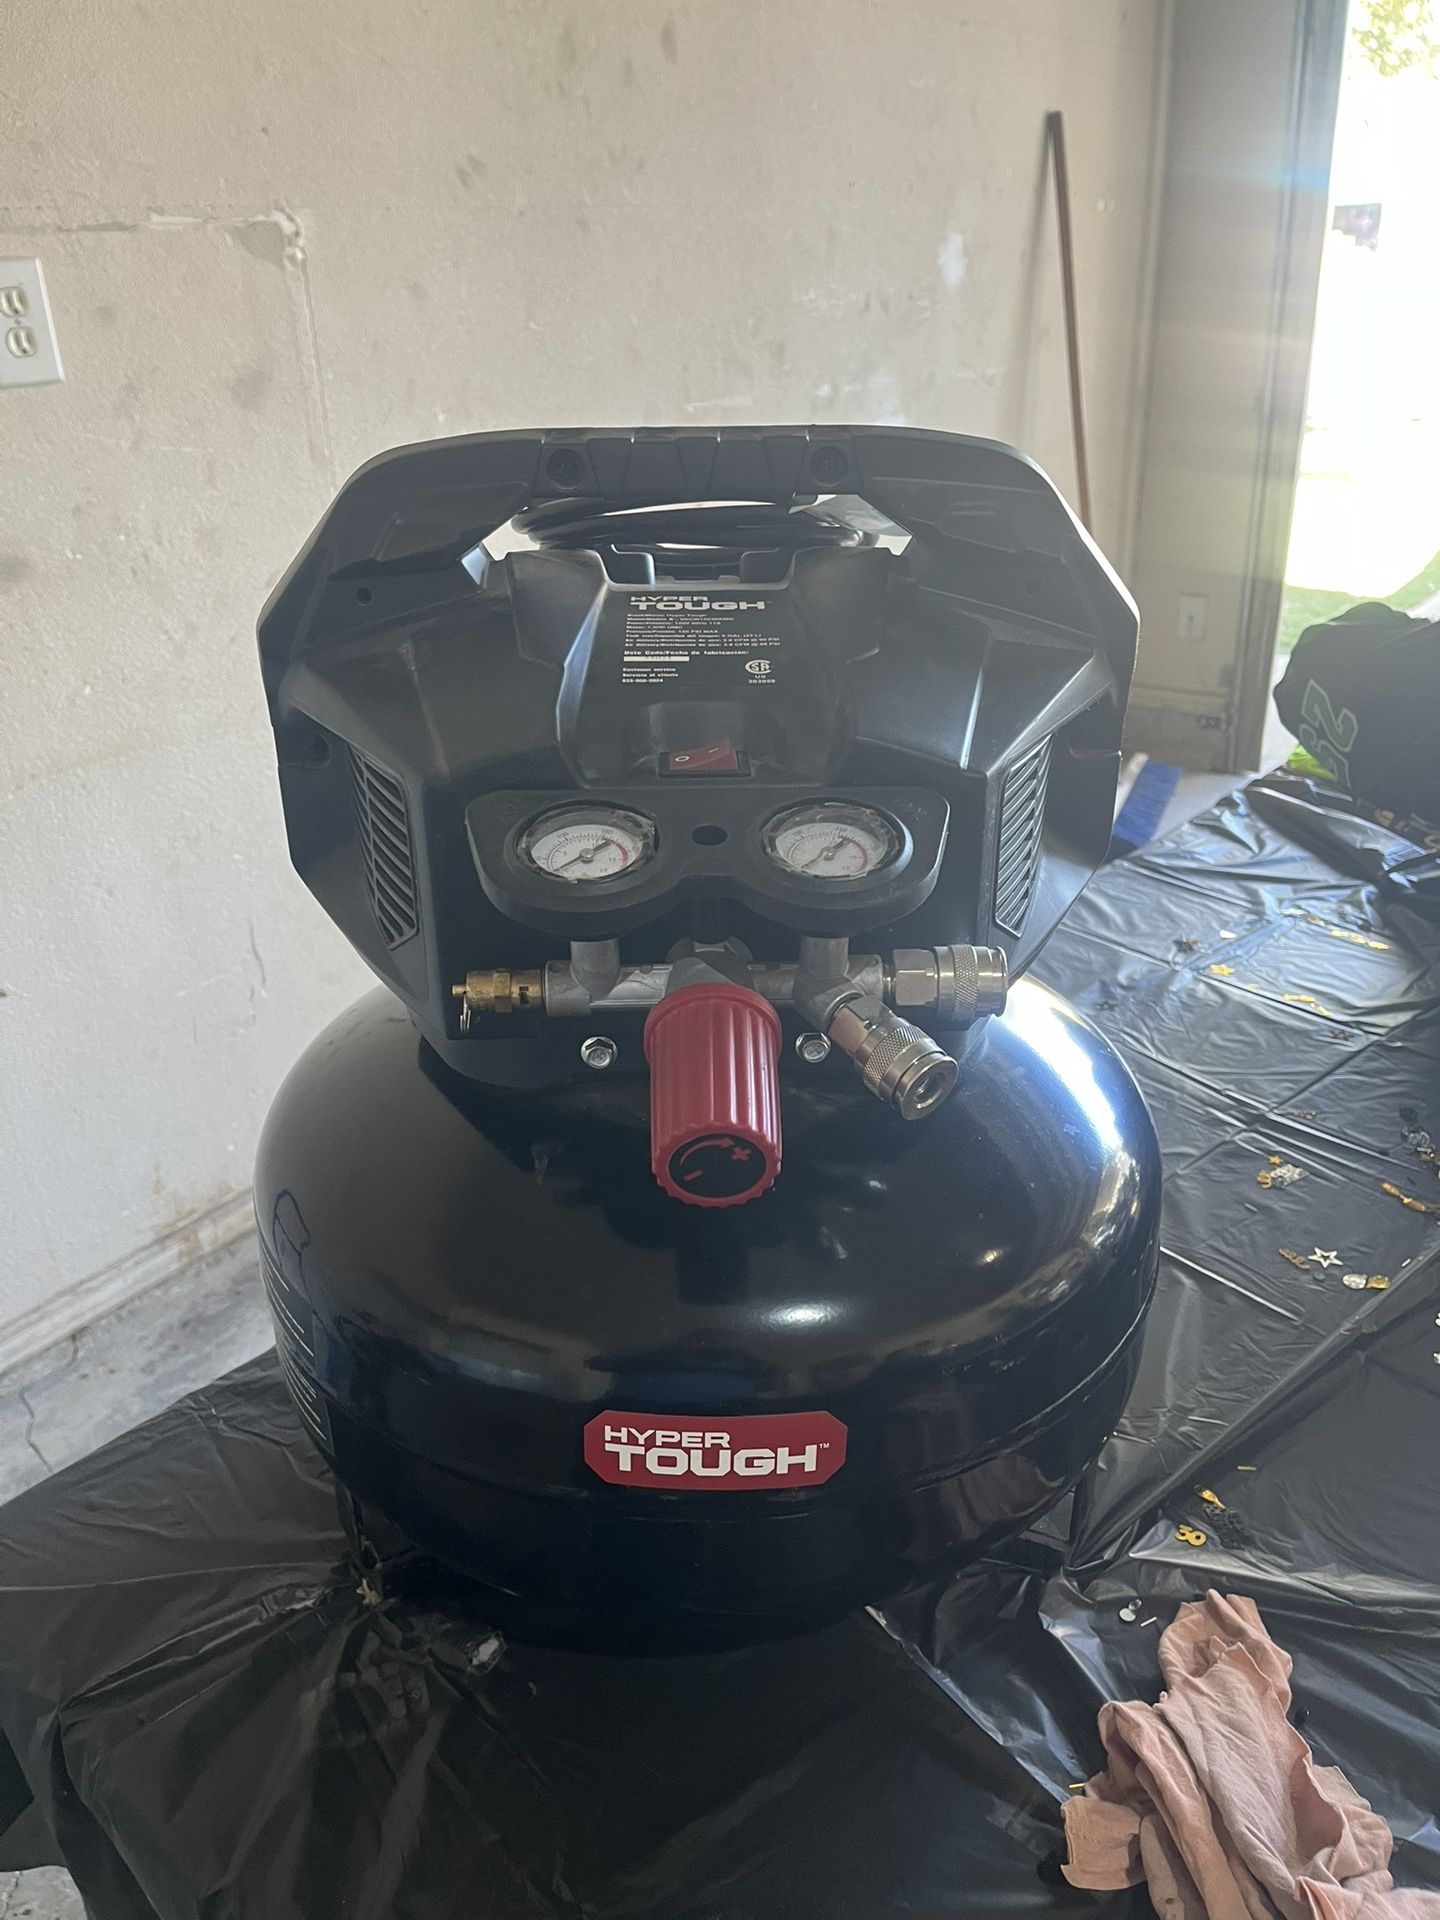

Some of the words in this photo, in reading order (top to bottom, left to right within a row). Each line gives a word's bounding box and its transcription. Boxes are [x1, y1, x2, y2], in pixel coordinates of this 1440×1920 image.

[630, 601, 765, 610] TOUGH
[604, 1425, 731, 1448] HYPER
[604, 1442, 818, 1477] TOUGH
